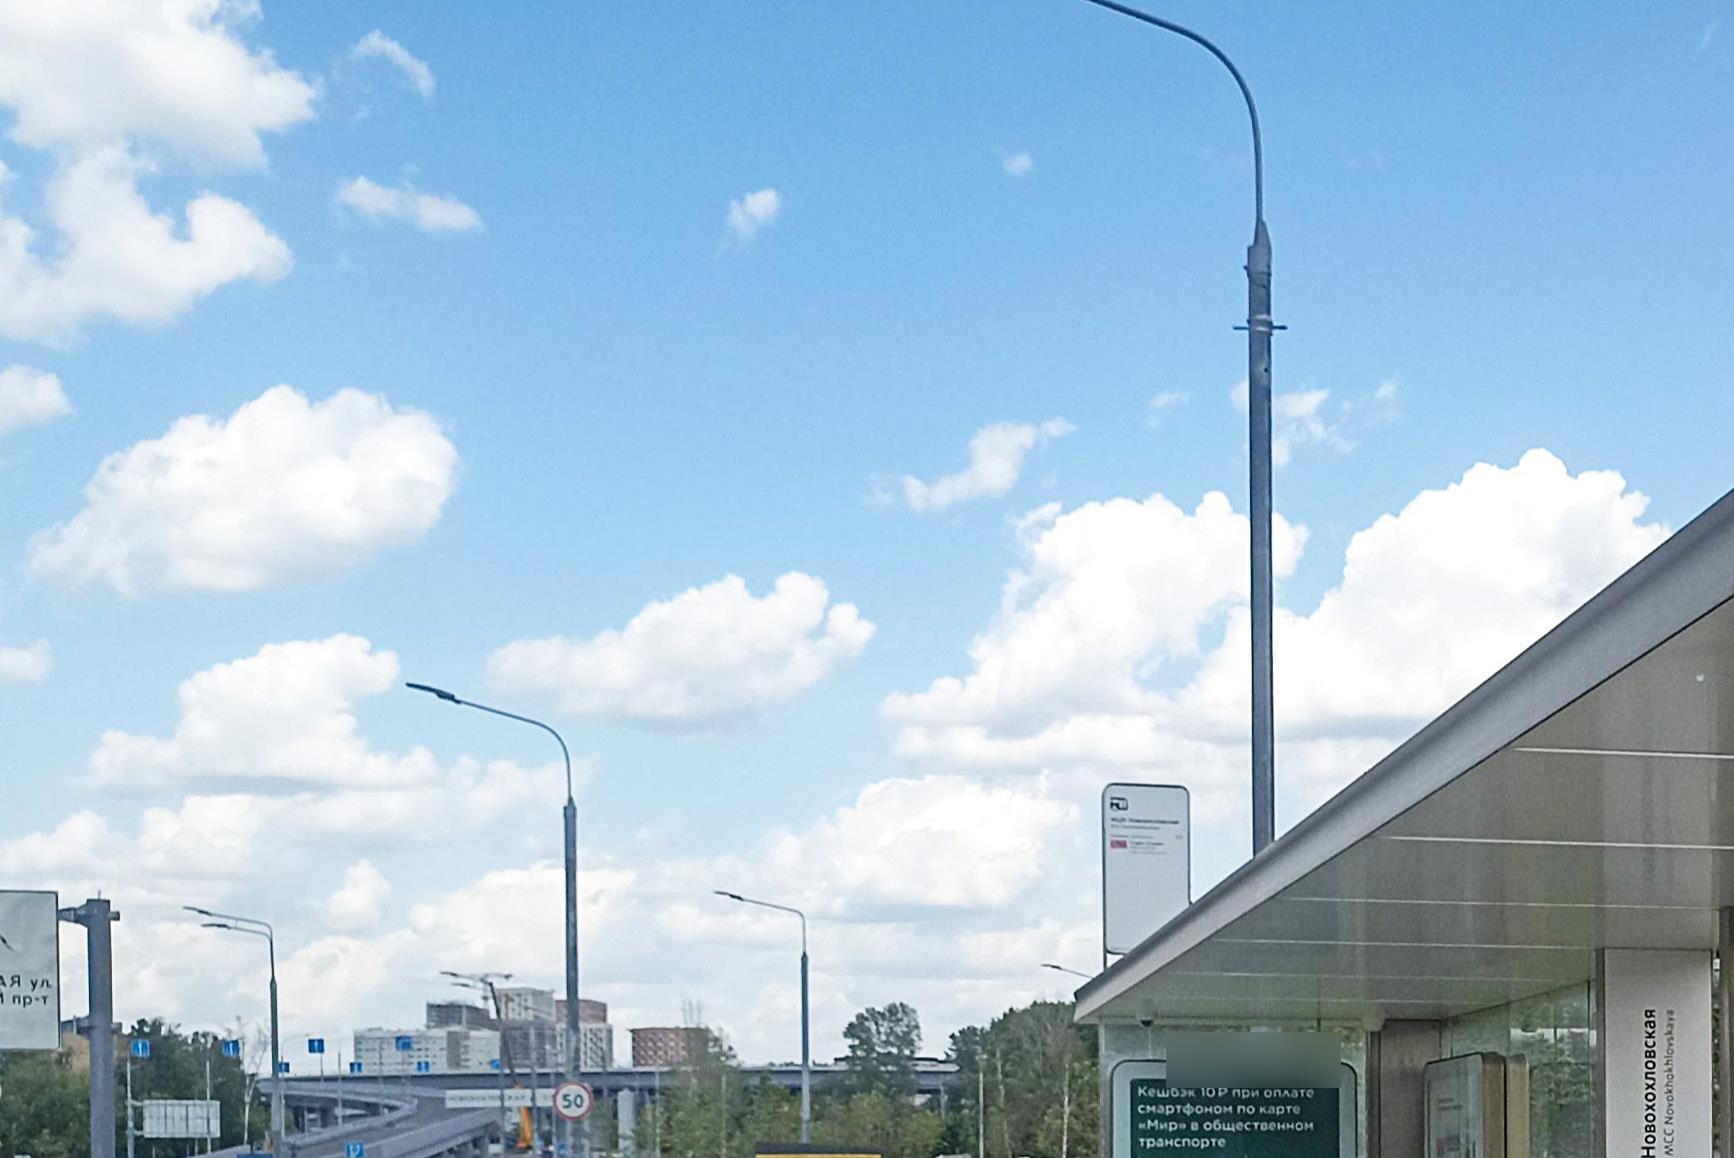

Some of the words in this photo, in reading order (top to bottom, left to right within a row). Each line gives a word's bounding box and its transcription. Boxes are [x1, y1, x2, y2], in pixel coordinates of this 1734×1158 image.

[1663, 1010, 1676, 1125] Novokhokhlovskaya
[1640, 1009, 1657, 1158] Новохохловская
[1137, 1086, 1197, 1098] Кешбэк
[1232, 1088, 1260, 1099] при
[1263, 1088, 1315, 1099] оплате
[562, 1093, 584, 1109] 50
[1137, 1103, 1233, 1116] смартфоном
[1236, 1105, 1256, 1115] по
[1259, 1105, 1301, 1116] карте
[1138, 1119, 1187, 1132] «Мир»
[1190, 1121, 1199, 1131] в
[1203, 1119, 1314, 1132] общественном
[1138, 1137, 1227, 1149] транспорте
[1663, 1128, 1674, 1157] MCC
